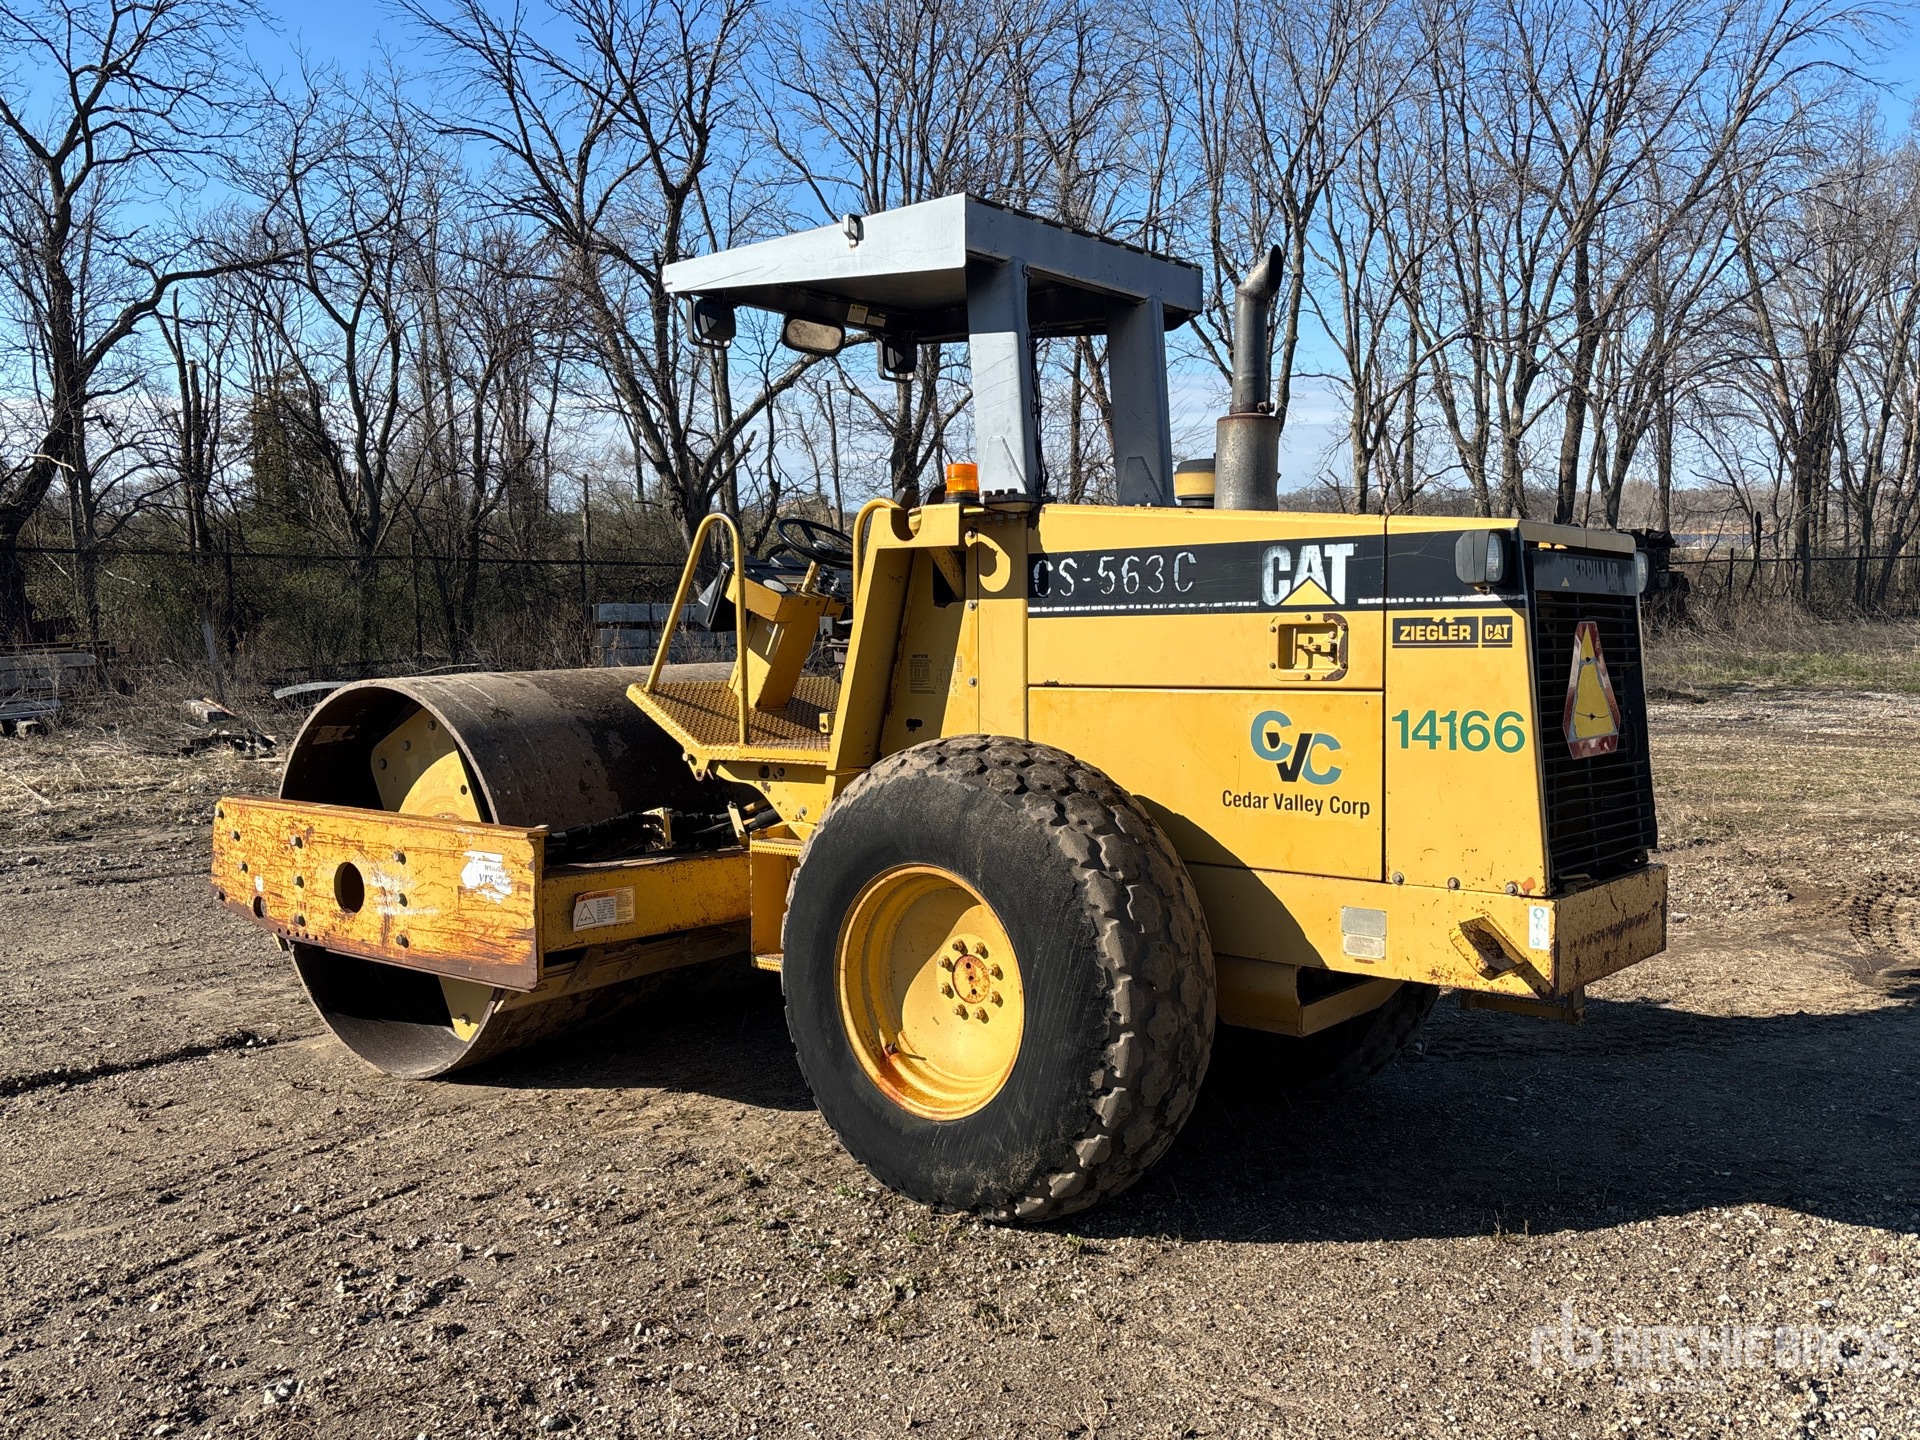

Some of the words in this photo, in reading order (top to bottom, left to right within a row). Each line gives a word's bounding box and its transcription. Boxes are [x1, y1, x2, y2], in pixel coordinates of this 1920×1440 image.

[1262, 543, 1355, 607] CAT
[1399, 625, 1472, 641] ZIEGLER
[1484, 624, 1511, 640] CAT
[1250, 709, 1343, 786] CVC
[1391, 709, 1526, 754] 14166
[1222, 789, 1269, 810] Cedar
[1273, 793, 1324, 816] Valley
[1329, 795, 1371, 820] Corp
